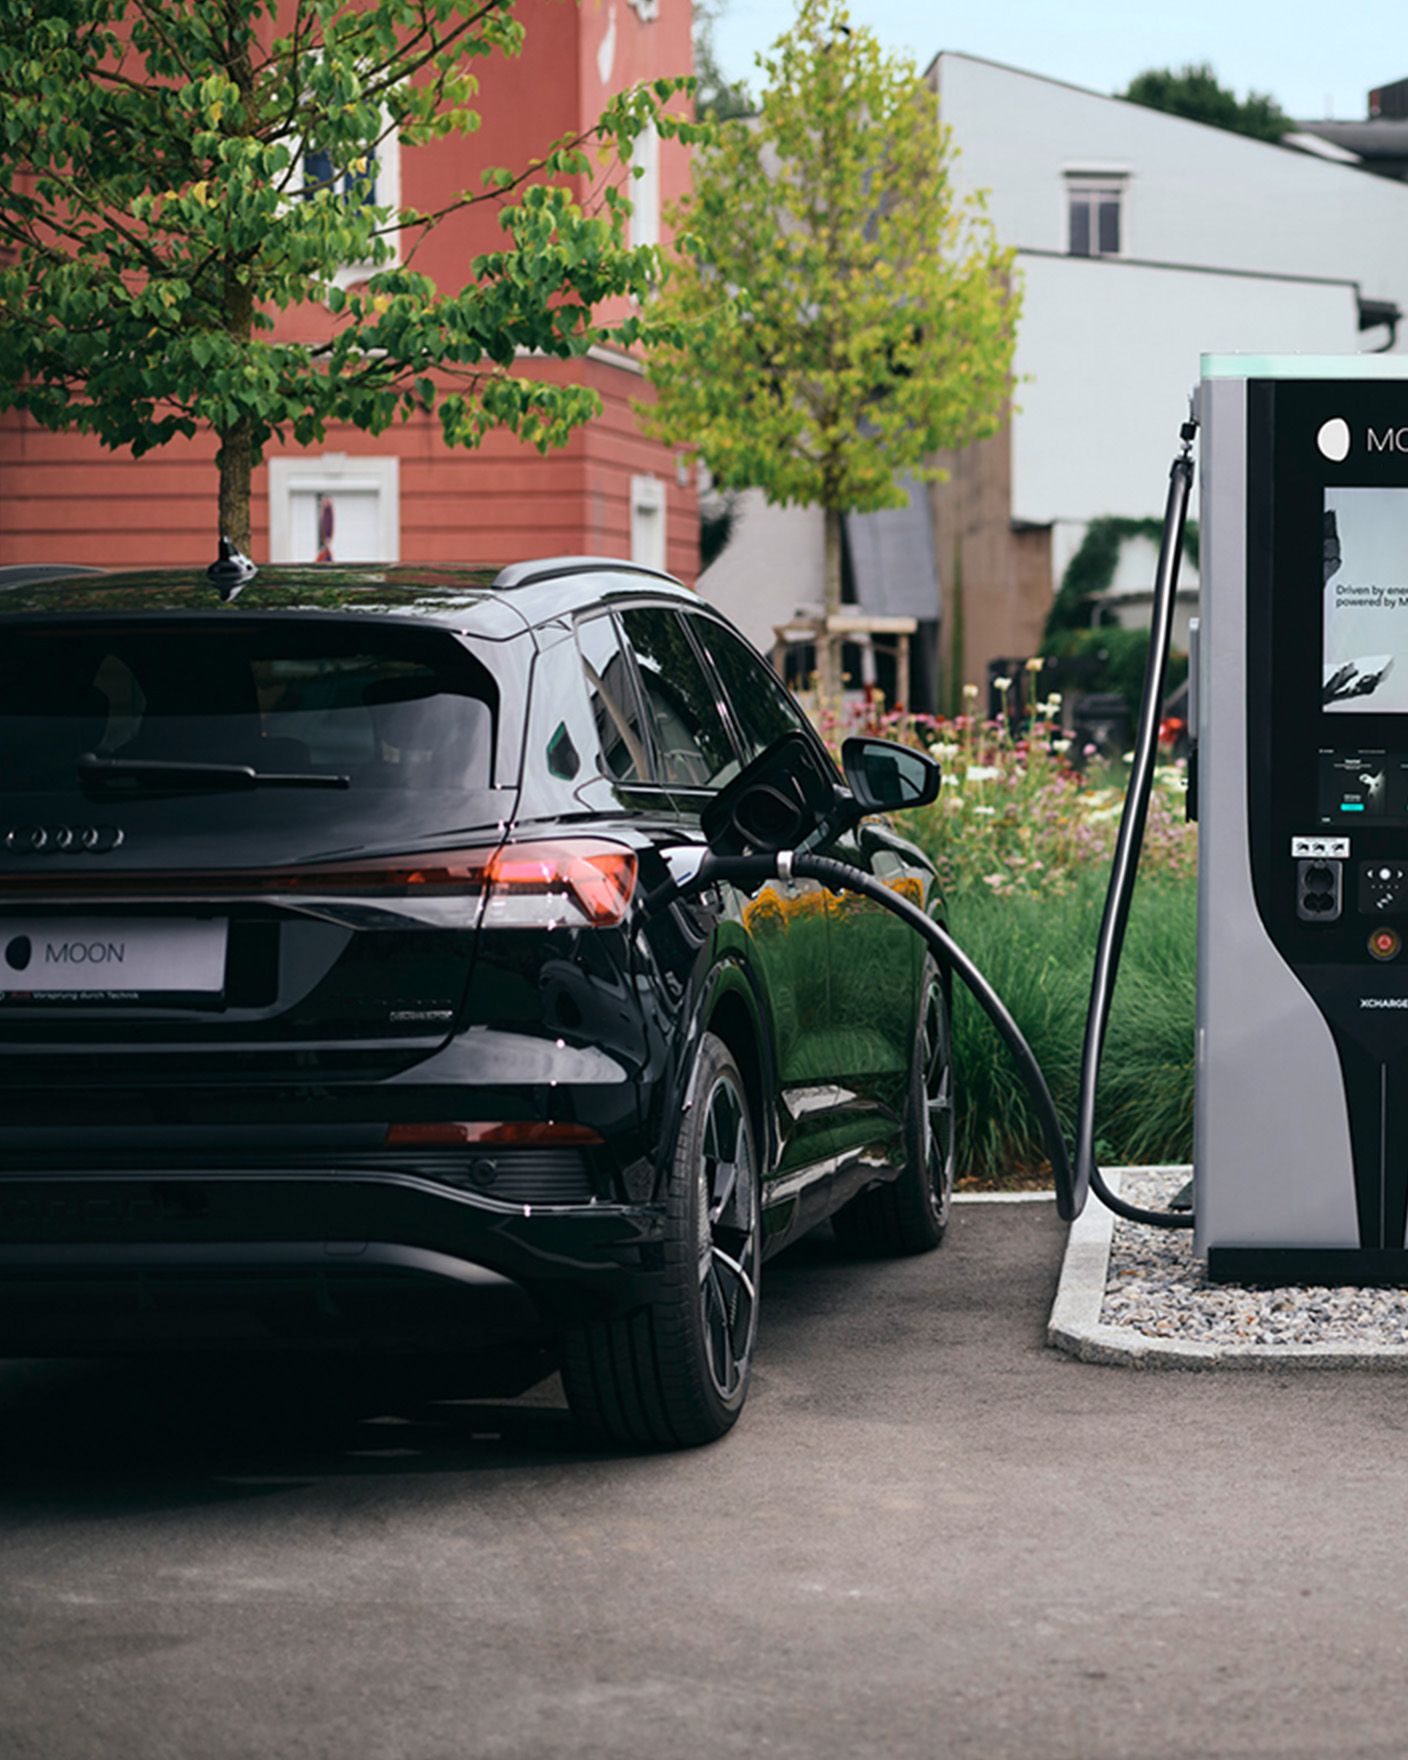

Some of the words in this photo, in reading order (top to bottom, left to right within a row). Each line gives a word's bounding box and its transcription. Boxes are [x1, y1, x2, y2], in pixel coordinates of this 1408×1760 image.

[1336, 584, 1370, 595] Driven
[1372, 584, 1385, 598] by
[1336, 597, 1382, 608] powered
[1384, 597, 1397, 609] by
[45, 942, 125, 964] MOON
[33, 991, 78, 1000] Vorsprung
[107, 991, 139, 999] Technik
[1360, 998, 1408, 1009] XCHARGE
